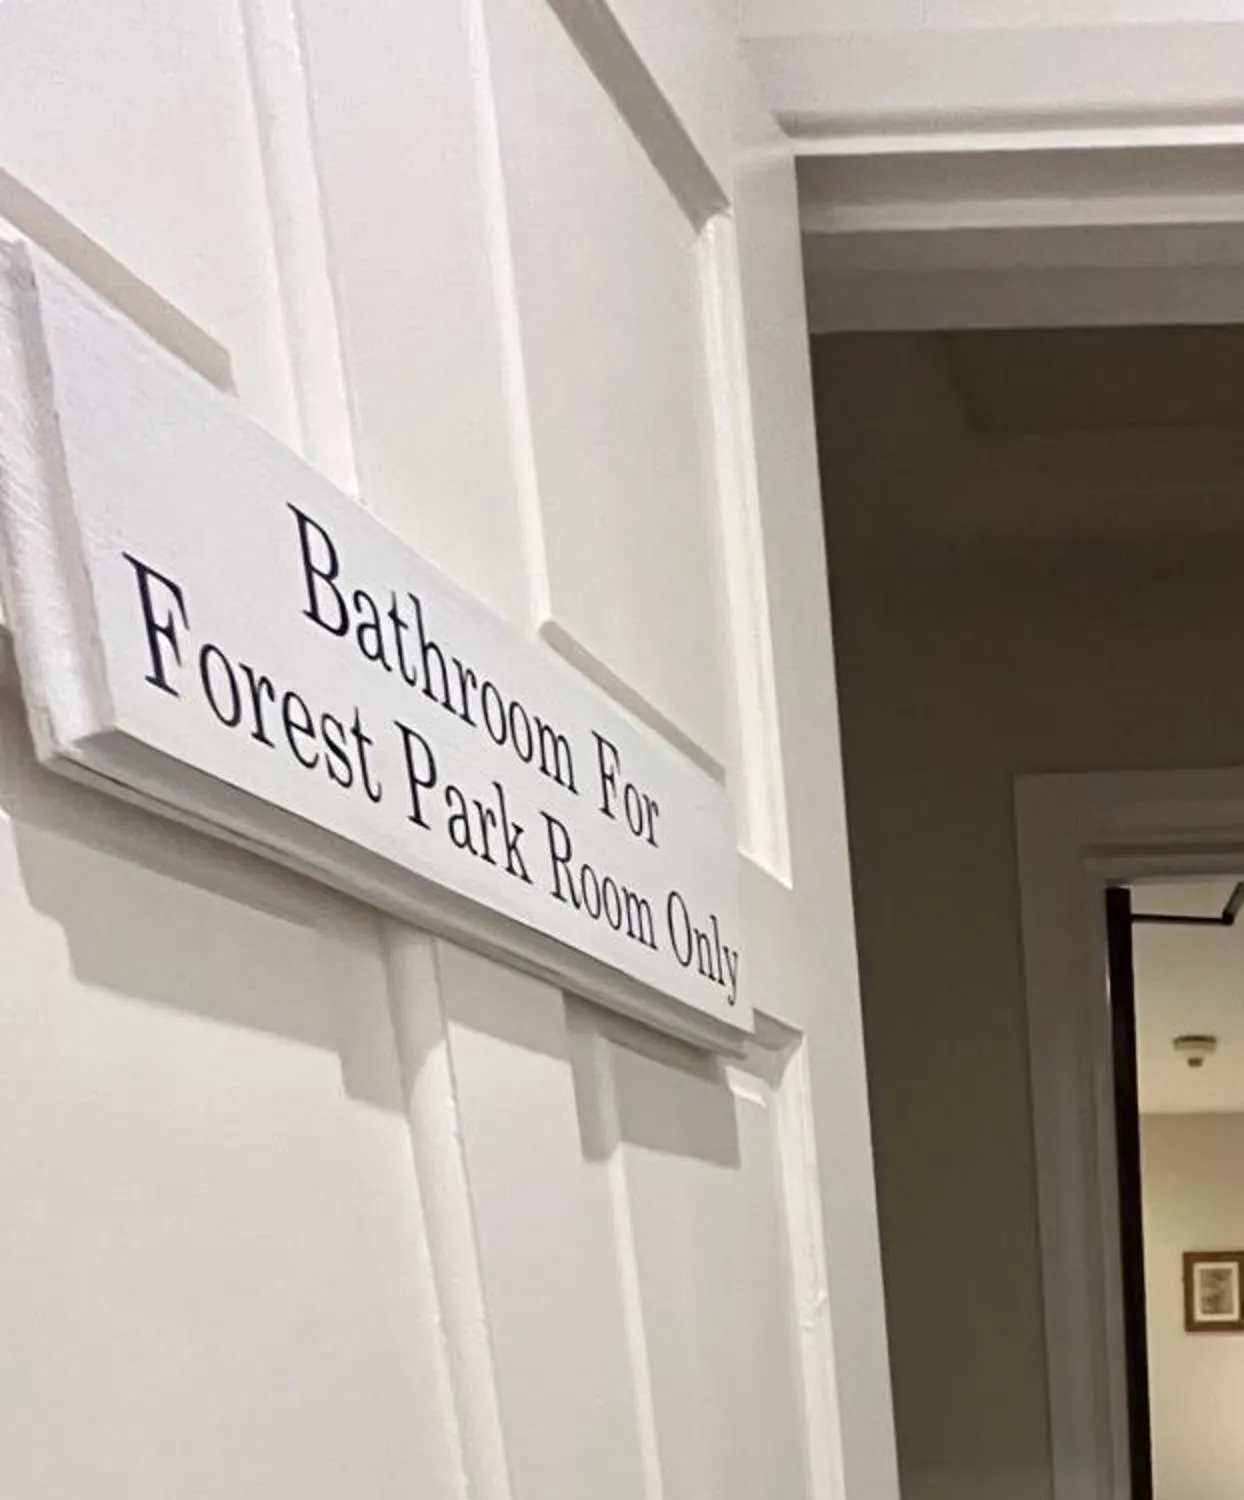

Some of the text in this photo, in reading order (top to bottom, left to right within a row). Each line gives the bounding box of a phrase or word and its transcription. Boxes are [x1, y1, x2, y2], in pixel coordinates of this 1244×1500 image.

[122, 551, 739, 1006] Forest Park Room Only
[287, 502, 660, 848] Bathroom For
